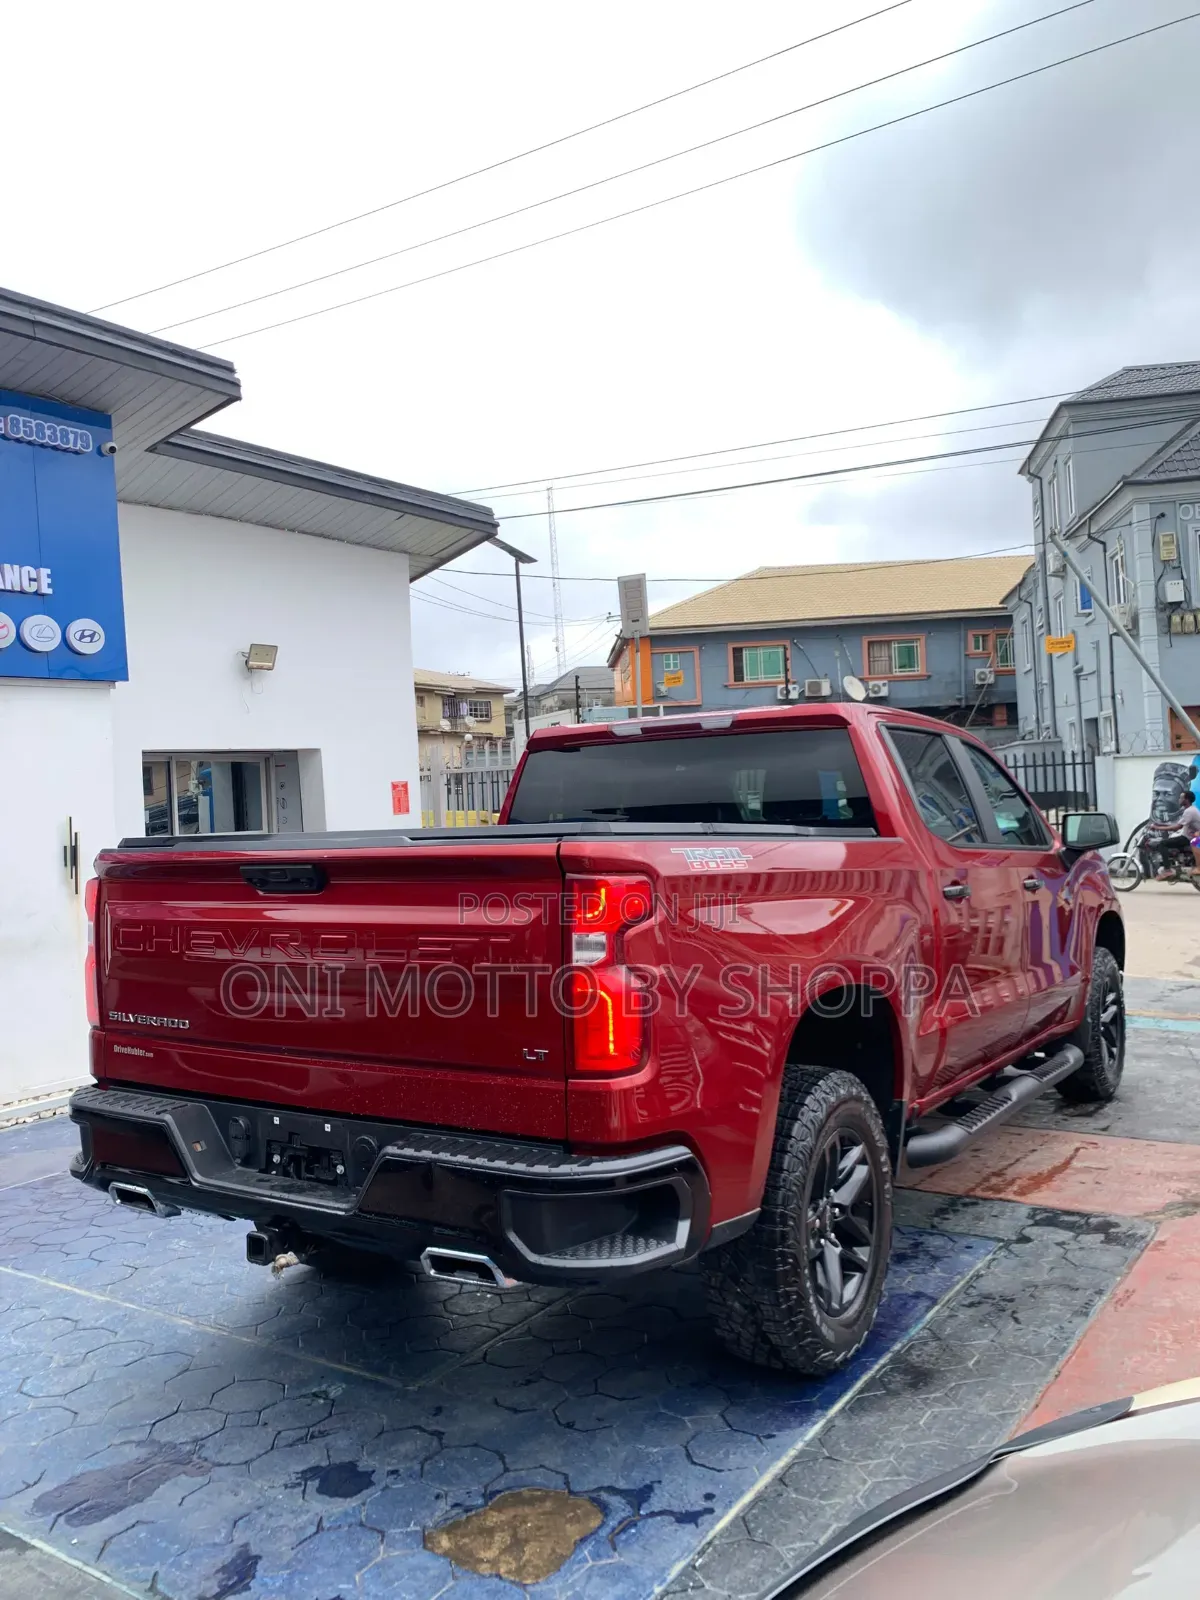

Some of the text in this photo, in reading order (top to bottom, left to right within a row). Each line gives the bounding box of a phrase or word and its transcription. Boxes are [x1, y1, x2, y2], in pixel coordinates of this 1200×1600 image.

[8, 414, 92, 452] 8583879
[670, 847, 753, 861] TRAIL
[688, 859, 749, 872] BOSS
[115, 923, 512, 965] CHEVROLET
[109, 1010, 190, 1029] SILVERADO
[523, 1048, 549, 1061] LT
